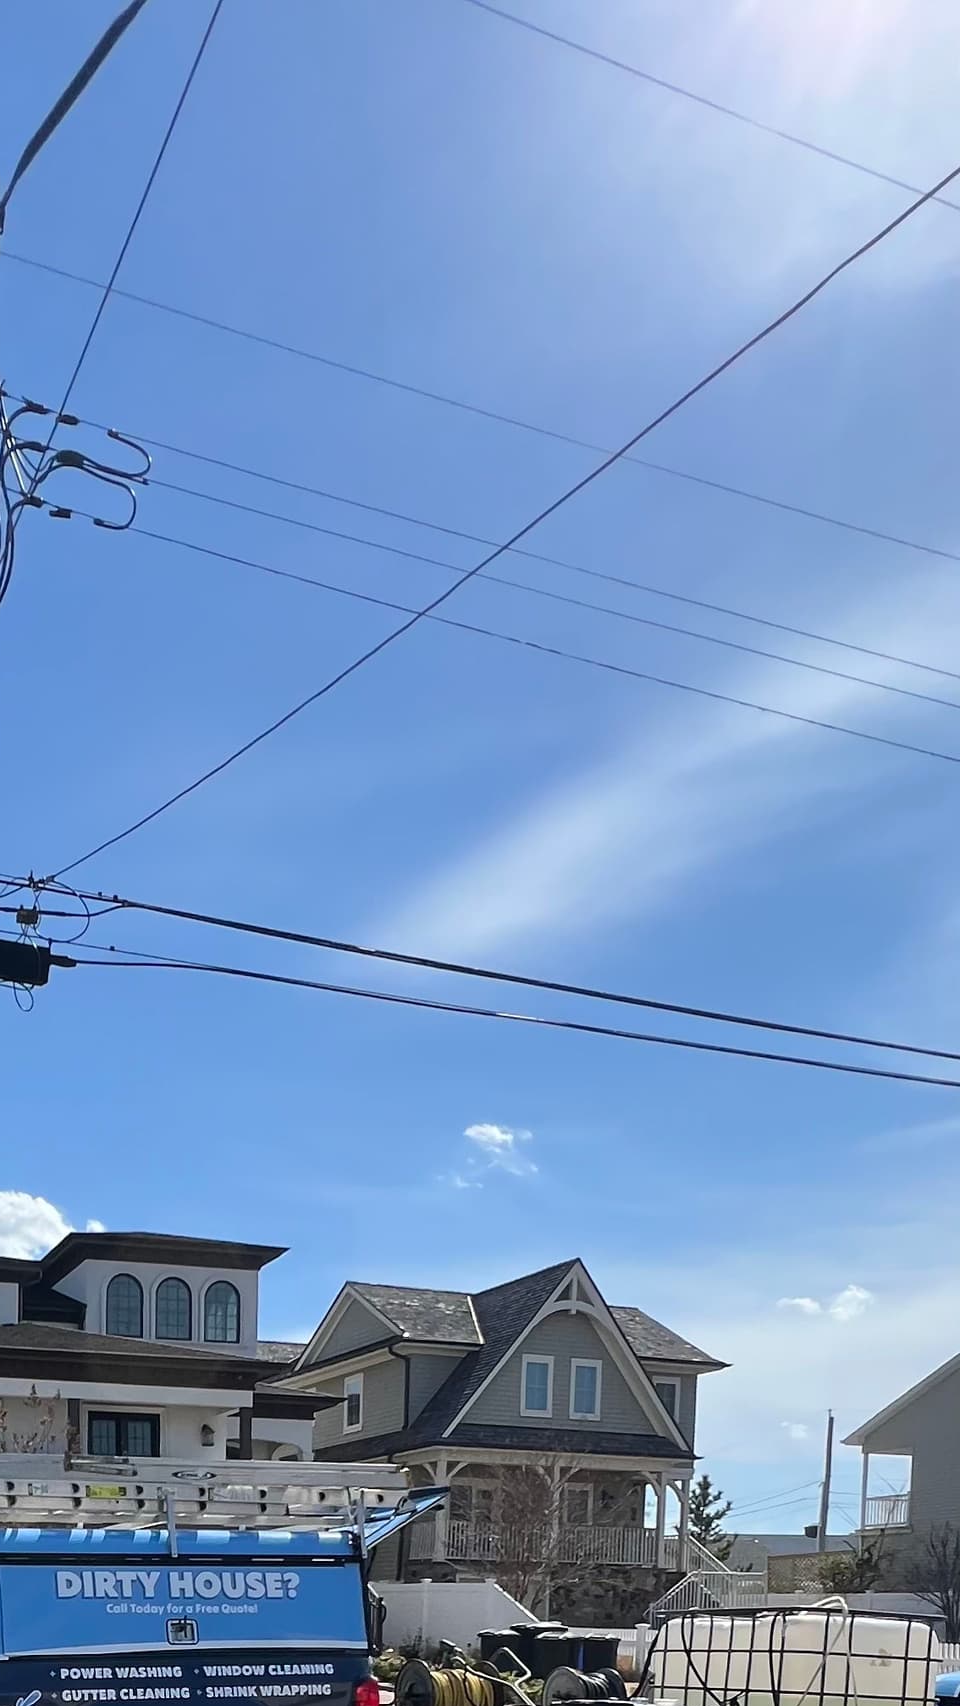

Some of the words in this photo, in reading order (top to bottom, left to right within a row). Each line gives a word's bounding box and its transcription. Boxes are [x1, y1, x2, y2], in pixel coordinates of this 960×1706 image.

[56, 1571, 160, 1599] DIRTY
[169, 1572, 300, 1600] HOUSE?
[106, 1603, 128, 1614] Call
[130, 1603, 164, 1615] Today
[166, 1603, 184, 1614] for
[185, 1605, 193, 1614] a
[195, 1604, 219, 1614] Free
[222, 1604, 258, 1614] Quote!
[60, 1668, 113, 1680] POWER
[115, 1666, 183, 1679] WASHING
[203, 1665, 265, 1677] WINDOW
[268, 1663, 334, 1675] CLEANING
[62, 1689, 117, 1701] GUTTER
[120, 1687, 190, 1700] CLEANING
[206, 1686, 257, 1698] SHRINK
[260, 1684, 331, 1697] WRAPPING
